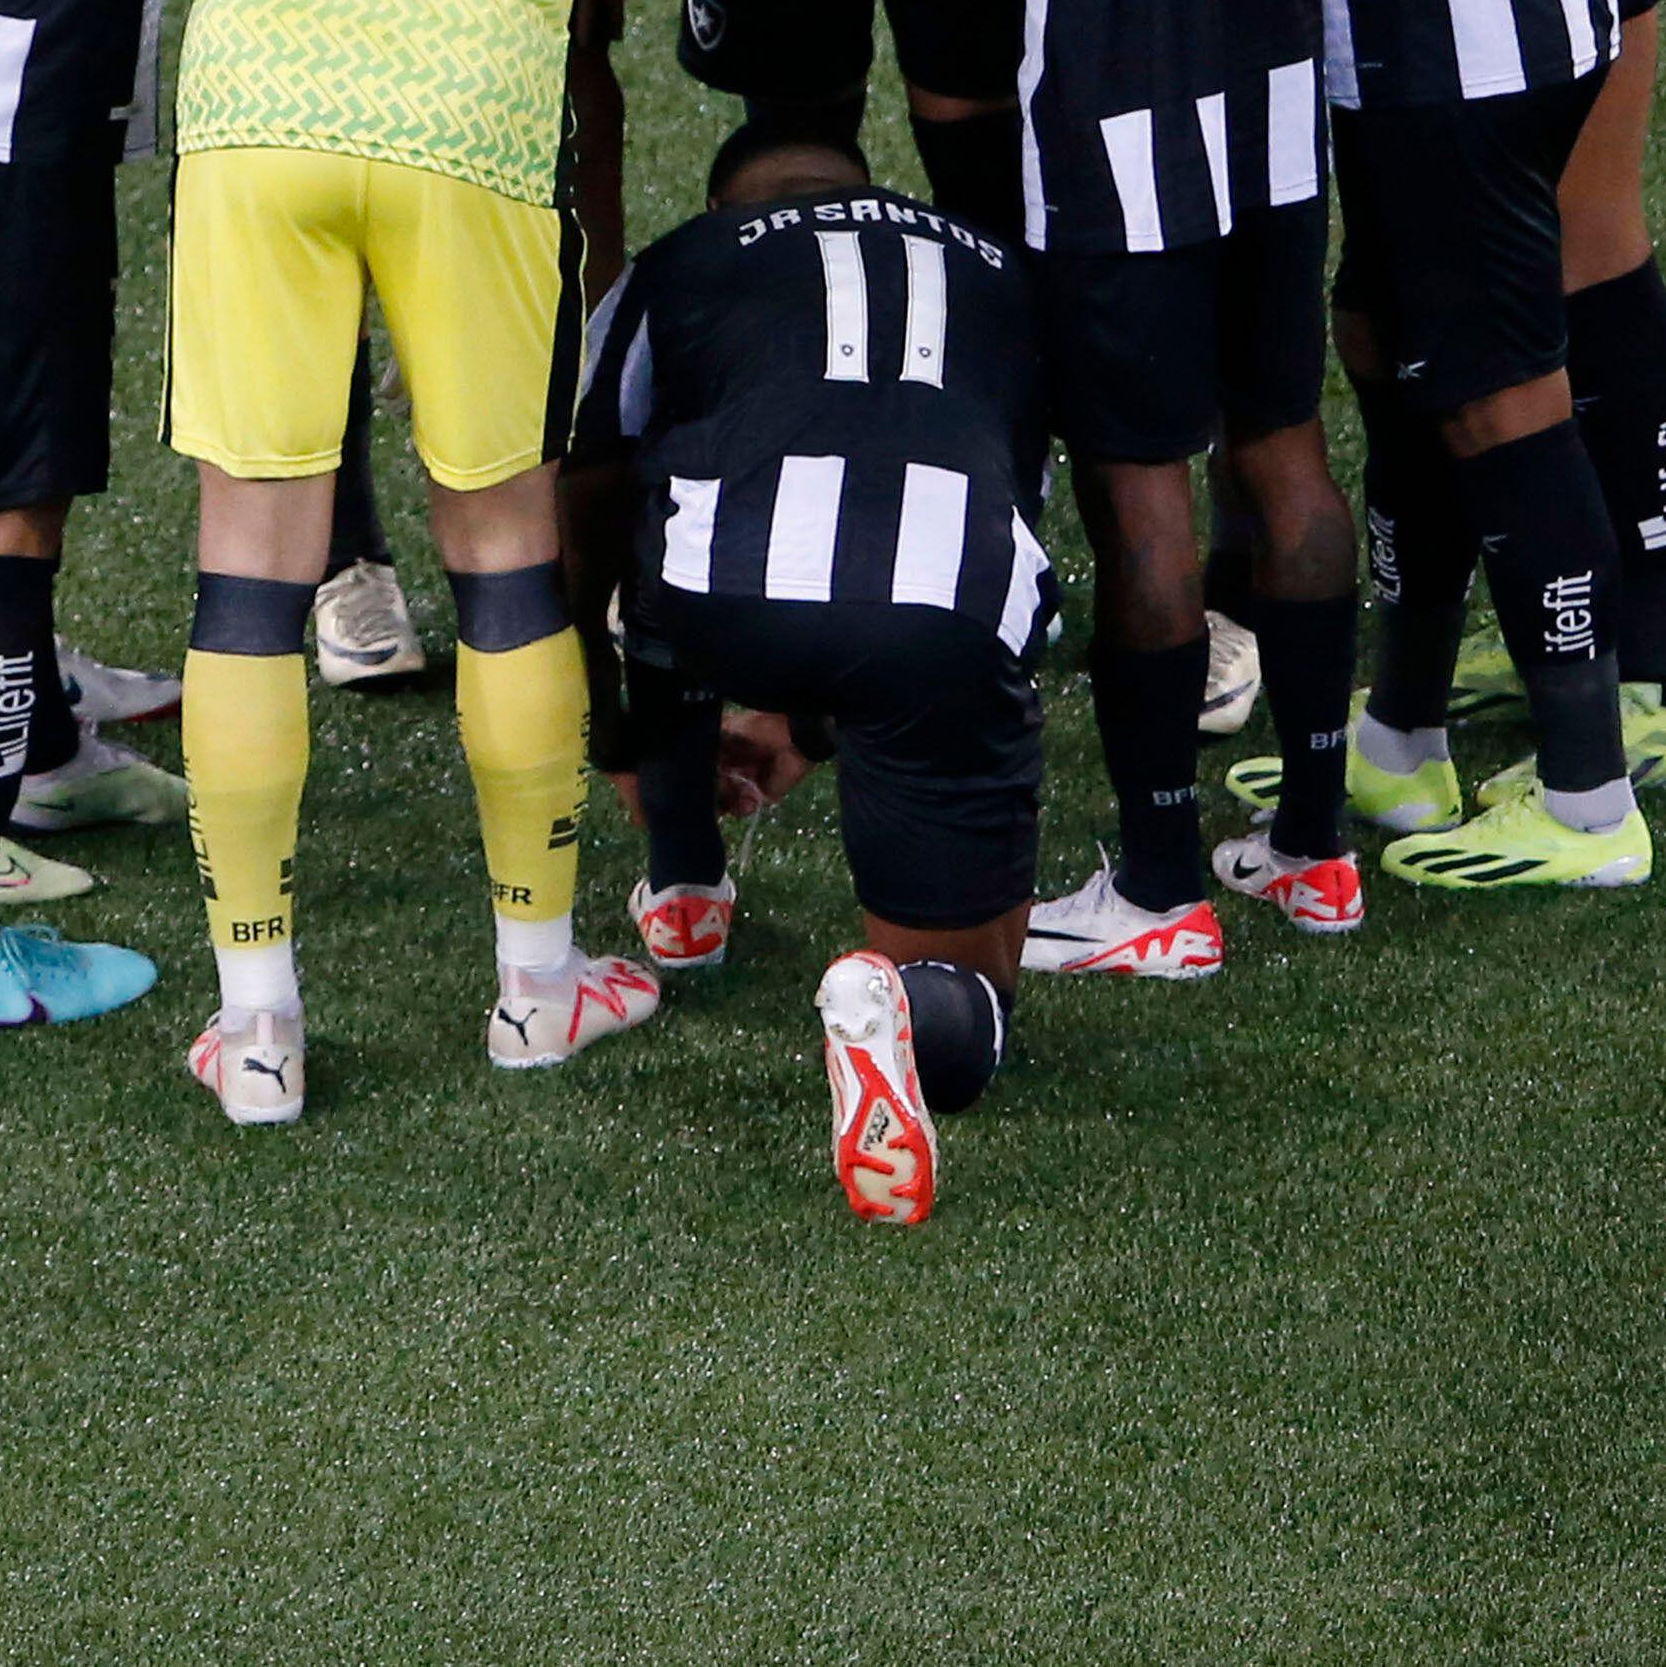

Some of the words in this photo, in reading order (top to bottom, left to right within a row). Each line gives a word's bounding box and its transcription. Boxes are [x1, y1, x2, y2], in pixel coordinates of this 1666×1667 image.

[813, 198, 1004, 270] SANTOS
[813, 230, 947, 390] 11
[232, 915, 285, 943] BFR
